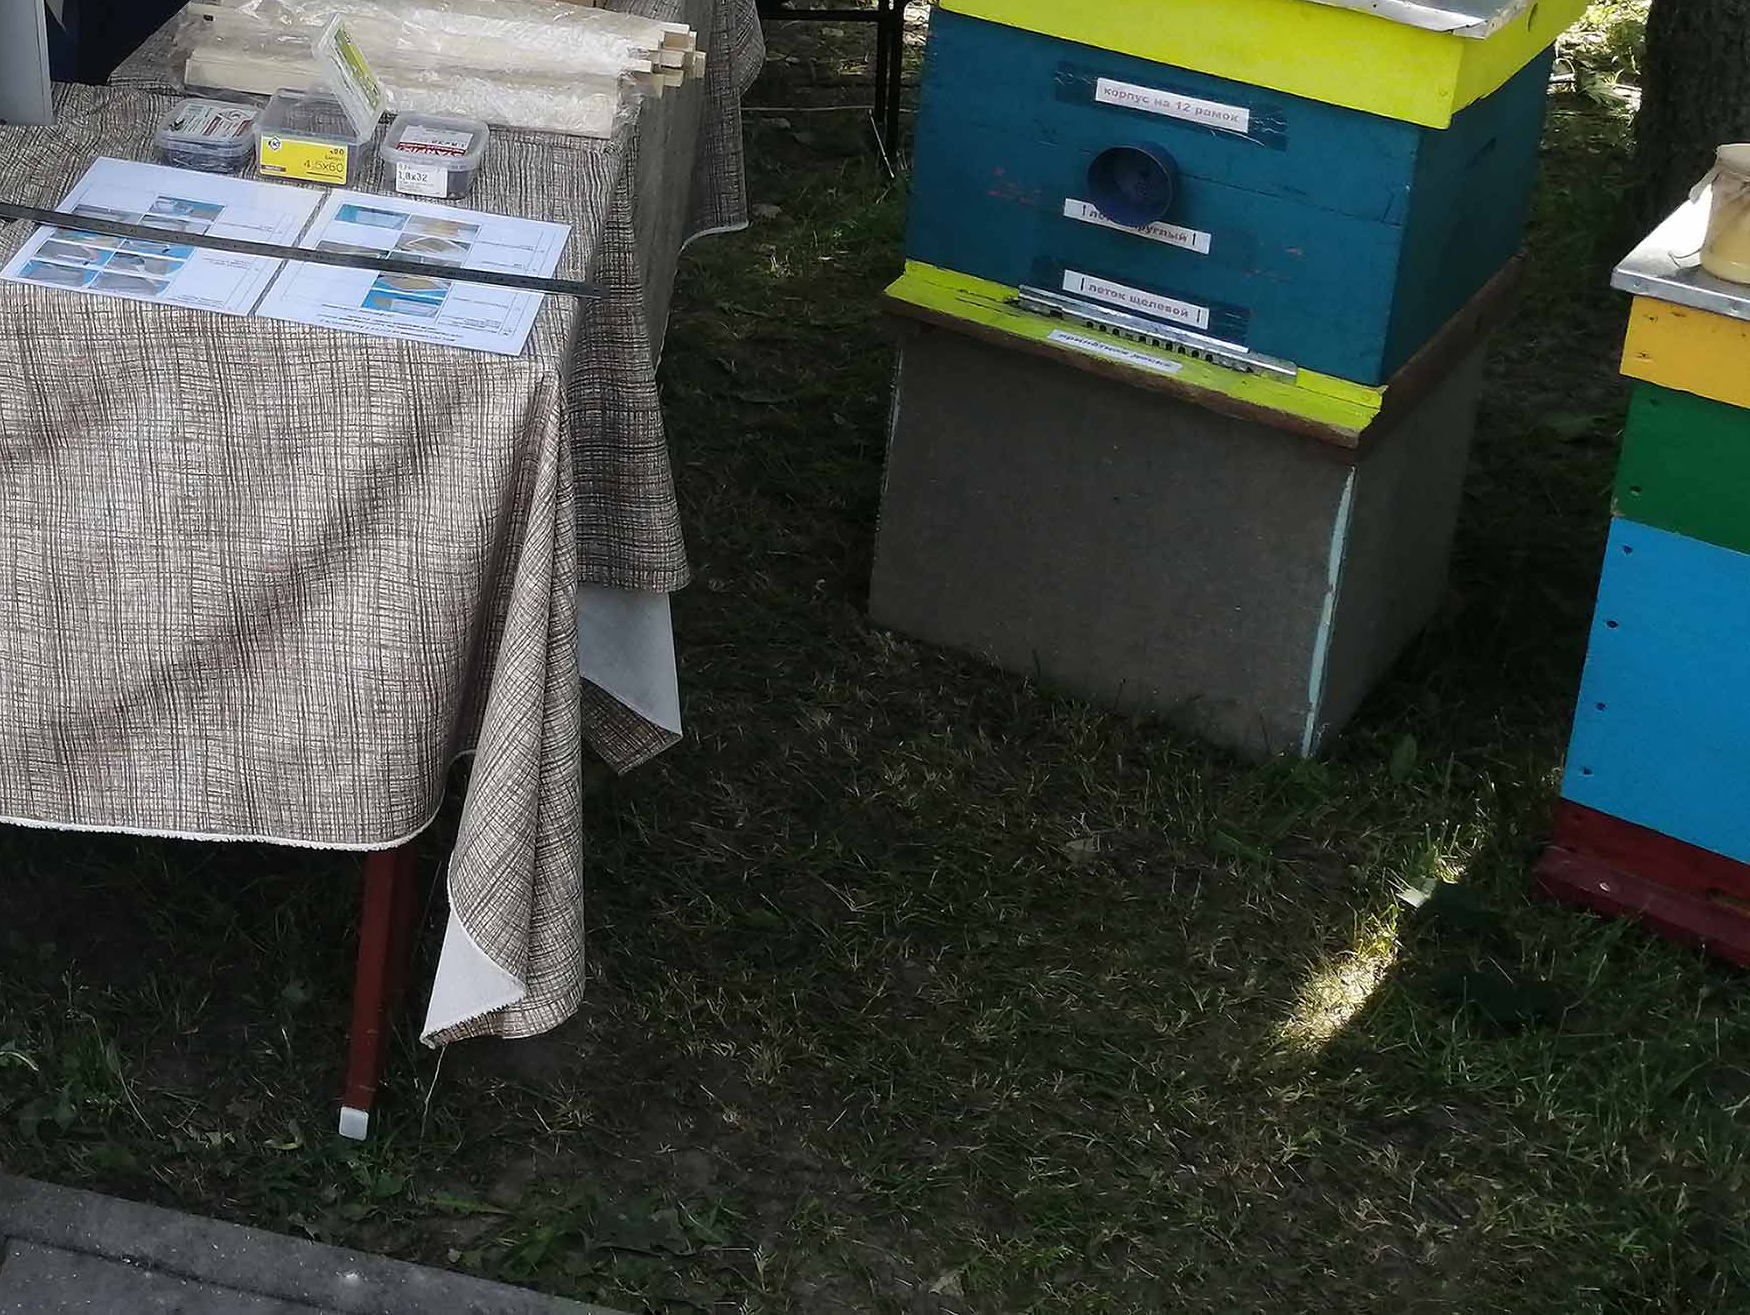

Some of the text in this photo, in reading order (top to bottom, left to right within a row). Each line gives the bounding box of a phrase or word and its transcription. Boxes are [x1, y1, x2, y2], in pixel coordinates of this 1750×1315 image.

[1103, 85, 1241, 123] корпус на 12 рамок
[1133, 224, 1188, 243] руглый
